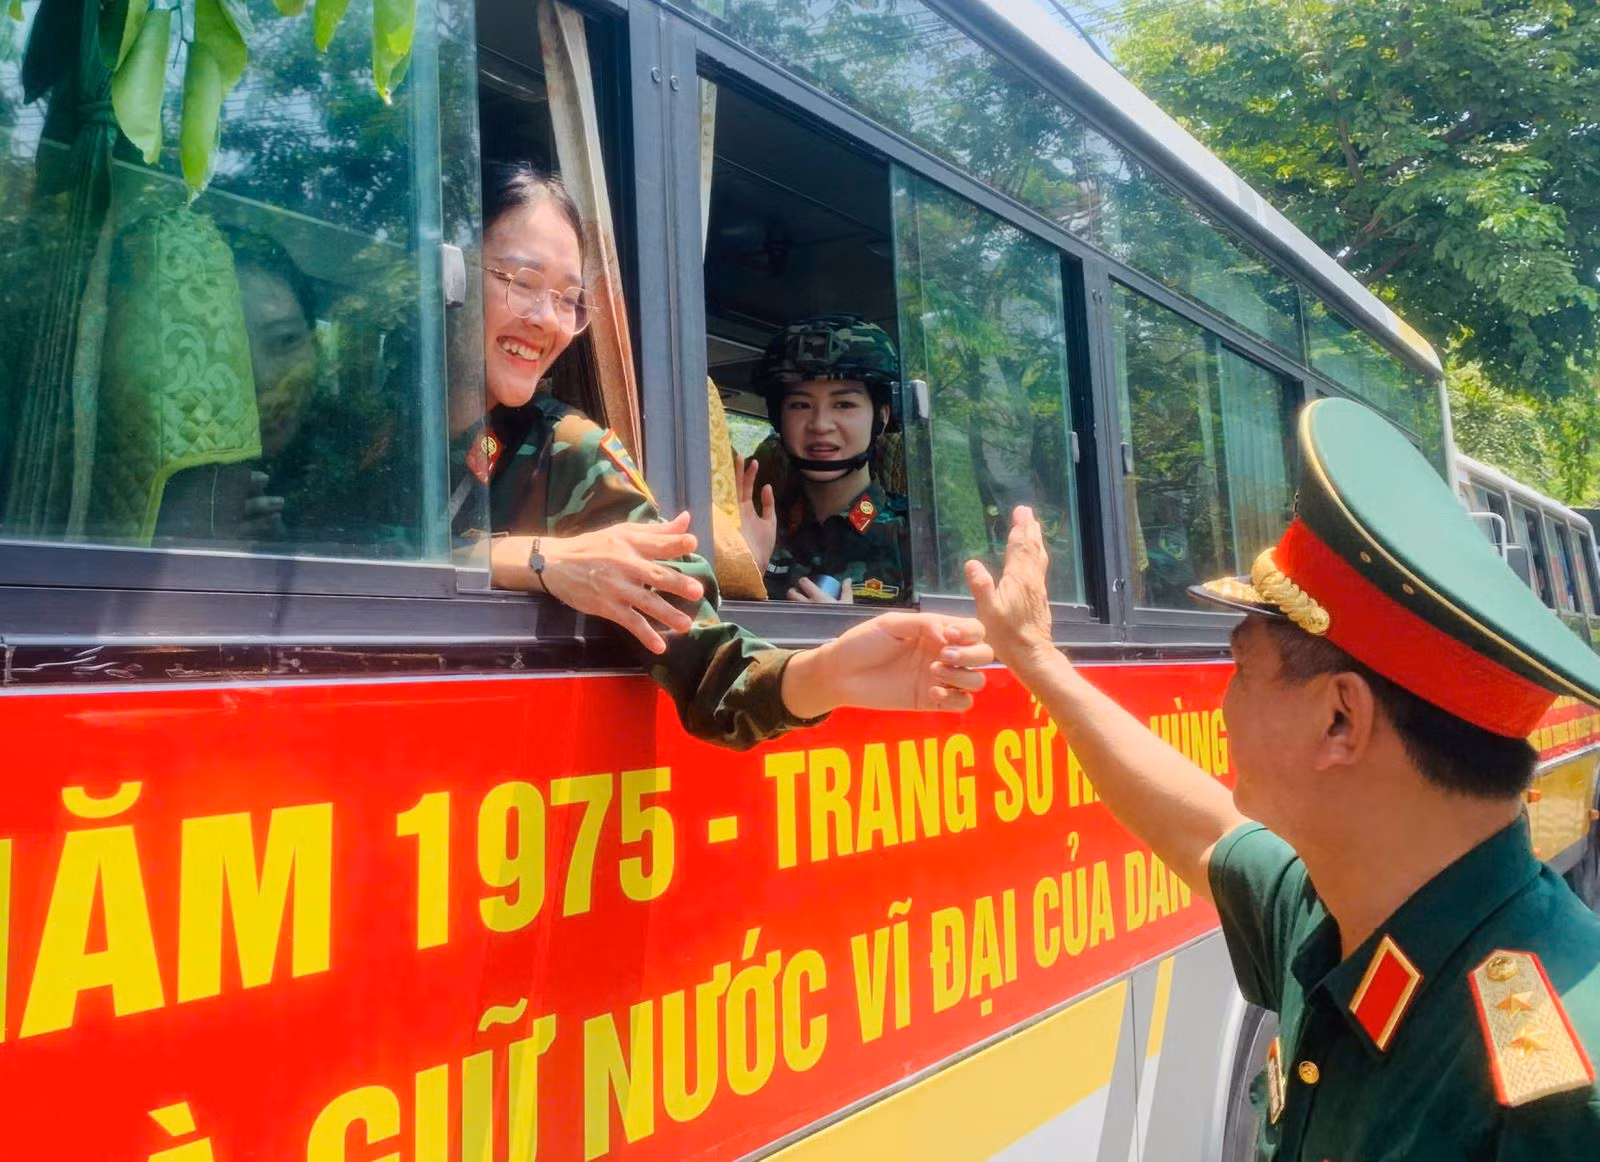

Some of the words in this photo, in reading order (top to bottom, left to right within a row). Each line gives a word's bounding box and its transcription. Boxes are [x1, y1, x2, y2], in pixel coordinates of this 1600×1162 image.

[0, 781, 333, 1043] ĂM
[396, 767, 675, 950] 1975
[708, 816, 738, 844] -
[764, 733, 978, 870] TRANG
[584, 927, 828, 1162] NƯỚC
[850, 898, 913, 1044] VĨ
[929, 889, 1018, 1017] ĐẠI
[1033, 831, 1116, 968] CỦA
